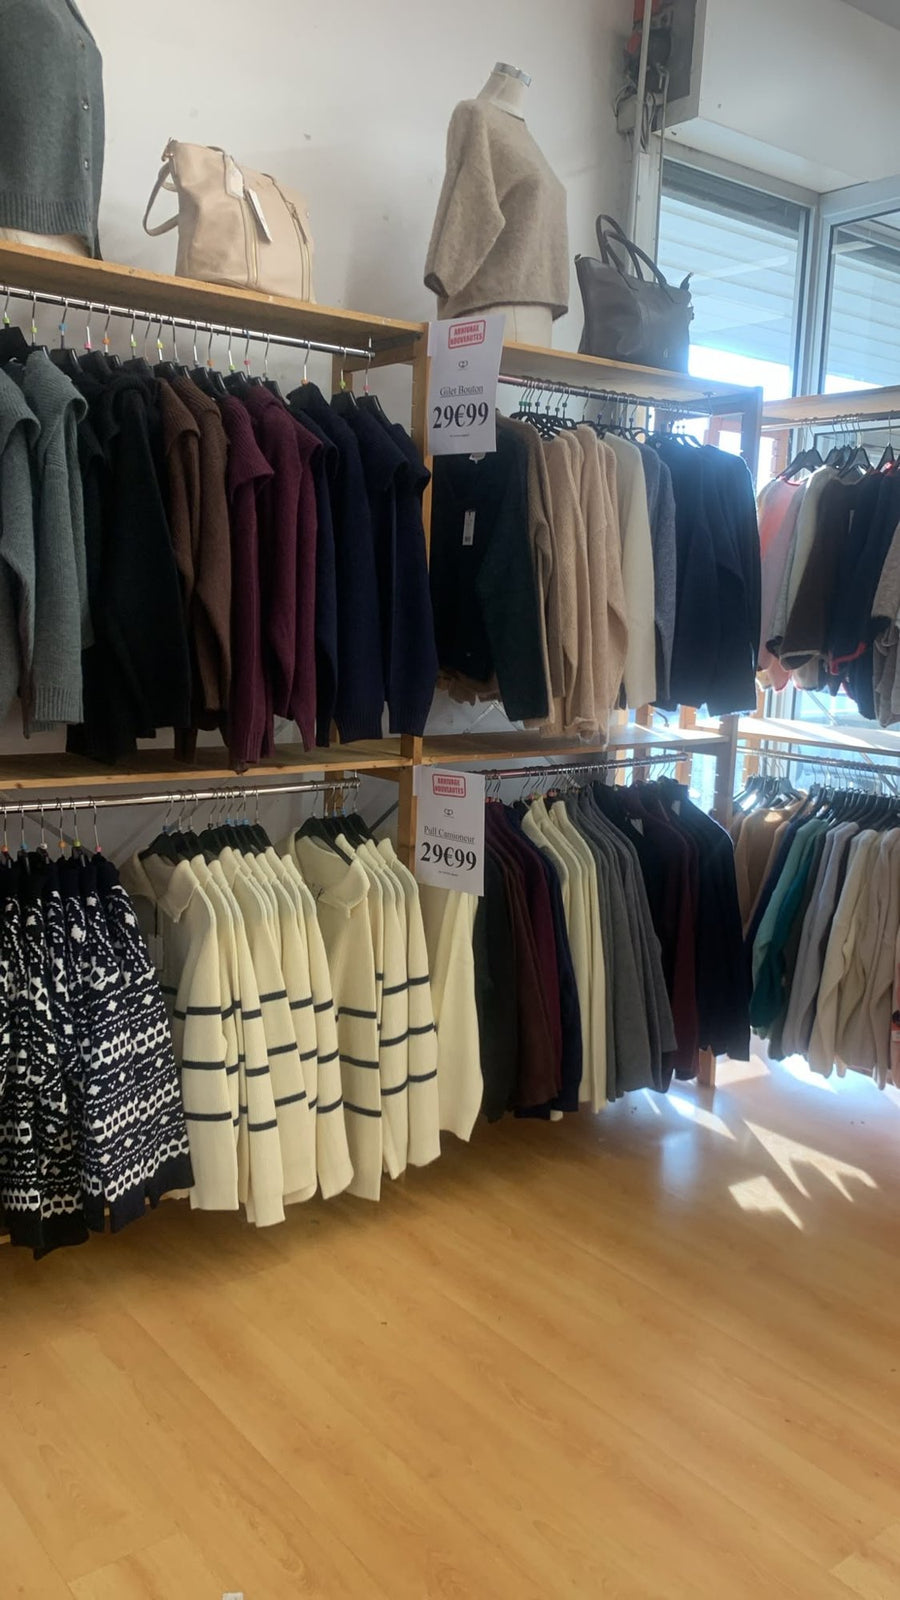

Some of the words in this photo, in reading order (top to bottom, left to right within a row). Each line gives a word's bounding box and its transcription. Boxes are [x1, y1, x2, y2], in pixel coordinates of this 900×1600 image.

[440, 386, 457, 397] Gilet
[458, 385, 484, 395] Bouton
[432, 401, 489, 429] 29€99
[424, 825, 437, 836] Pull
[420, 841, 477, 871] 29€99
